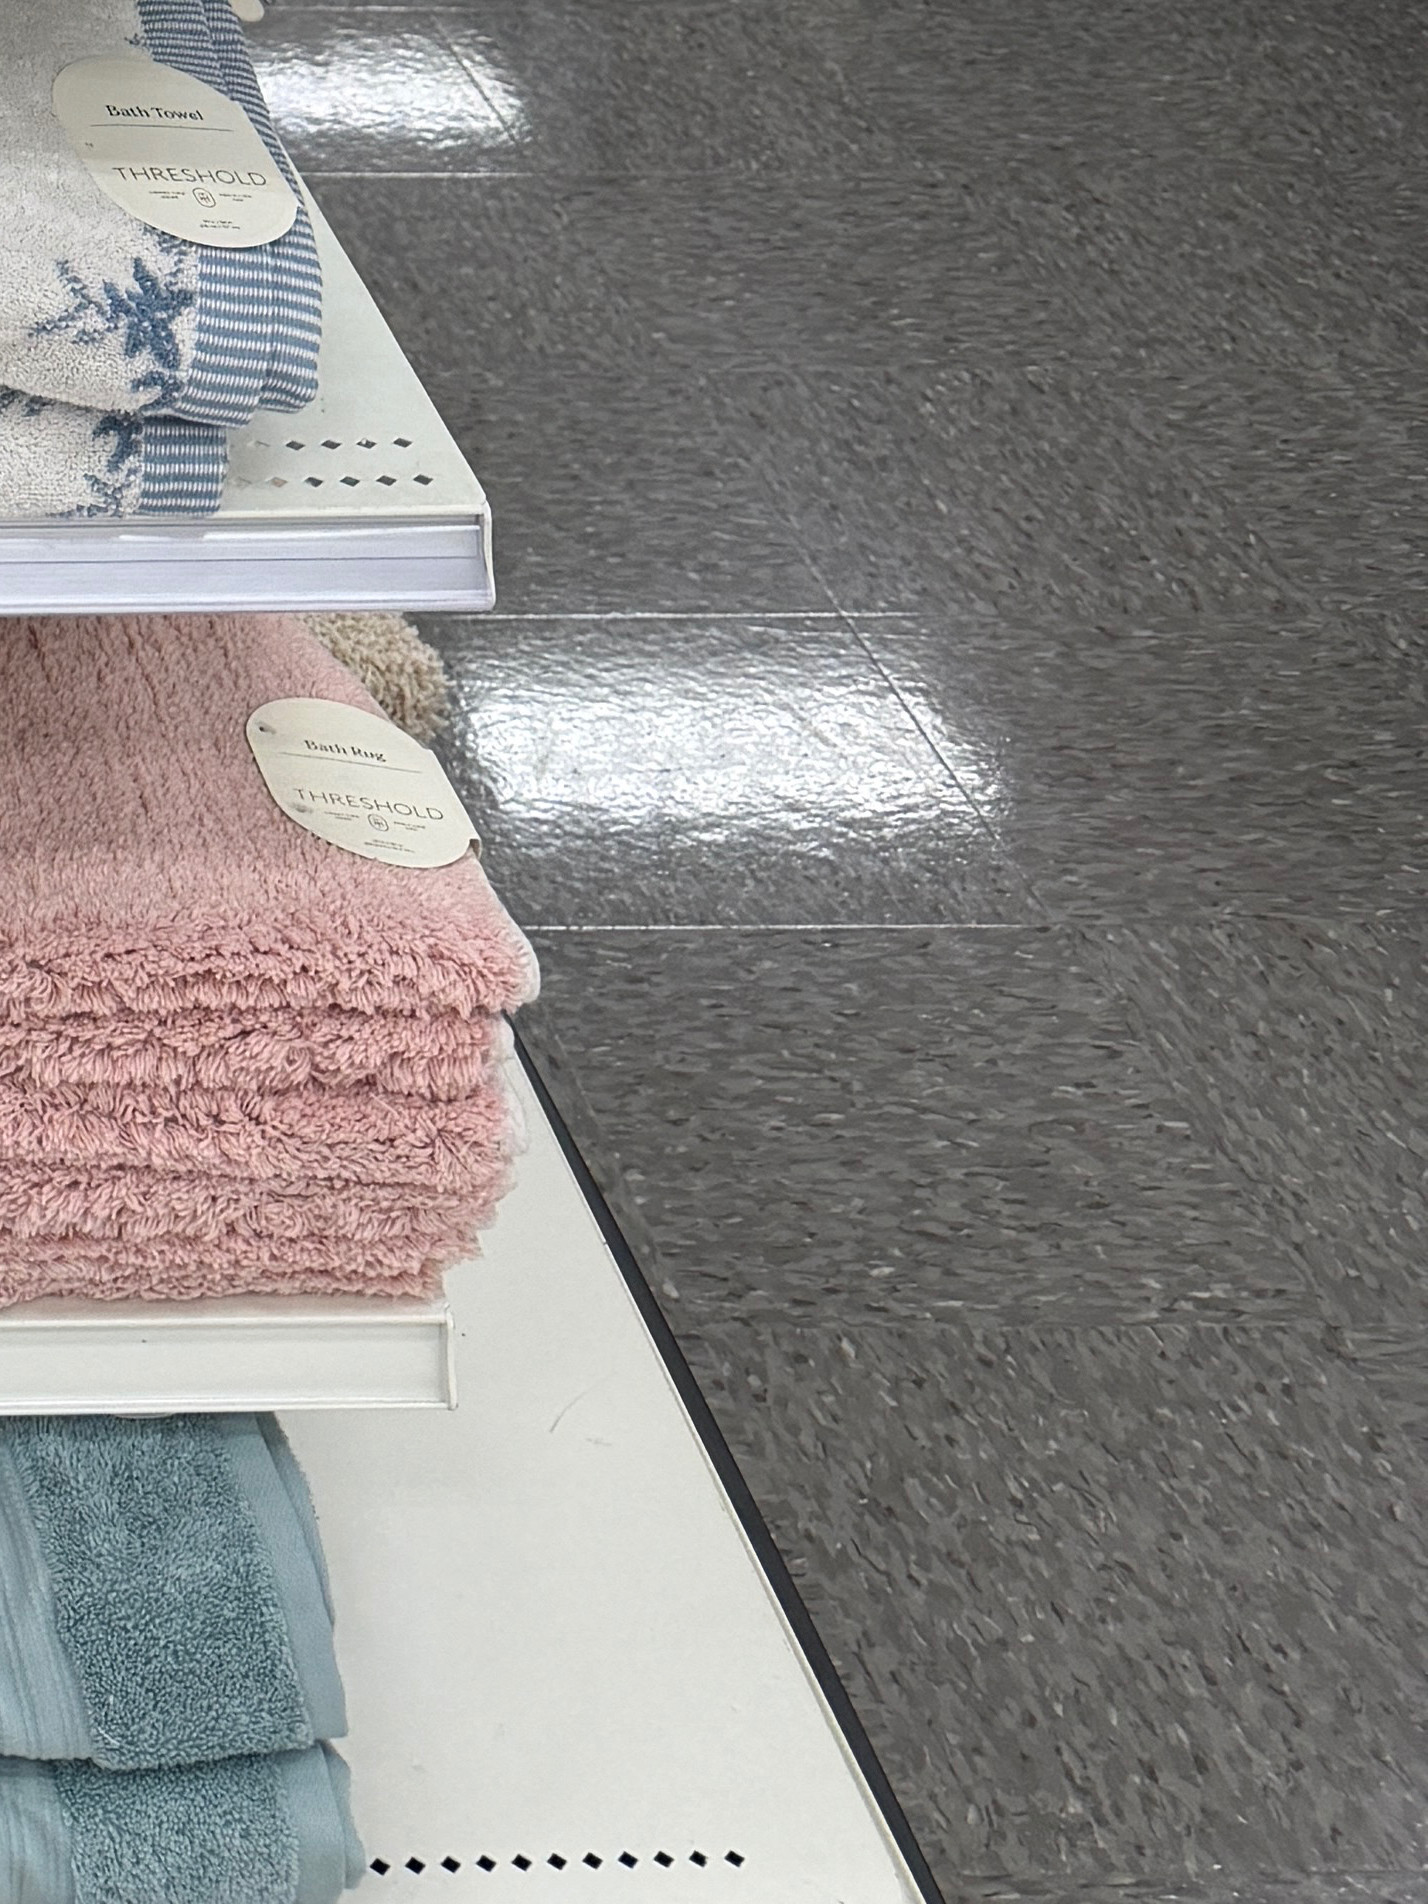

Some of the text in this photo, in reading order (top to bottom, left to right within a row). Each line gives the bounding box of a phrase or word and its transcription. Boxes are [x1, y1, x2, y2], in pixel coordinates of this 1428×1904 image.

[105, 105, 204, 120] Bath Towel
[112, 167, 267, 186] THRESHOLD
[304, 740, 387, 762] Bath Rug
[294, 788, 444, 820] THRESHOLD
